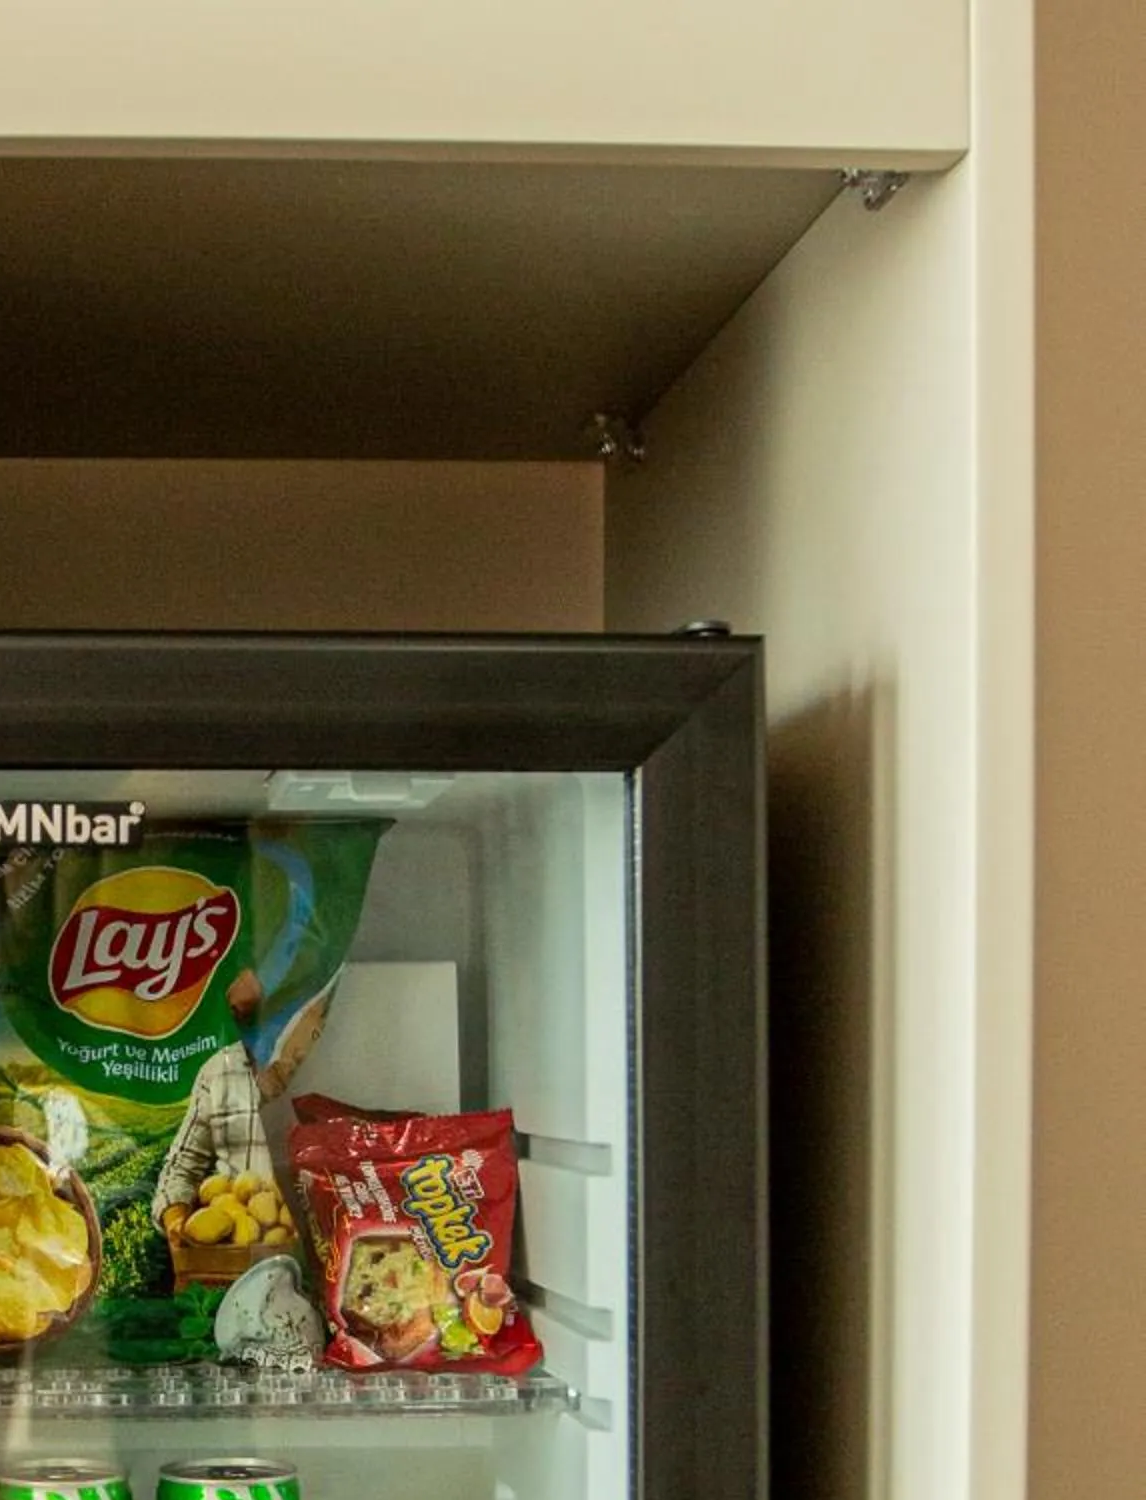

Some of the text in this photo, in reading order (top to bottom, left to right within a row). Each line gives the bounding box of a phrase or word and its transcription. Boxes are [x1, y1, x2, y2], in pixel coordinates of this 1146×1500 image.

[62, 896, 229, 1001] Lay's
[56, 1035, 219, 1063] Yoğurt ve Mevsim
[102, 1060, 180, 1083] Yeşillikli
